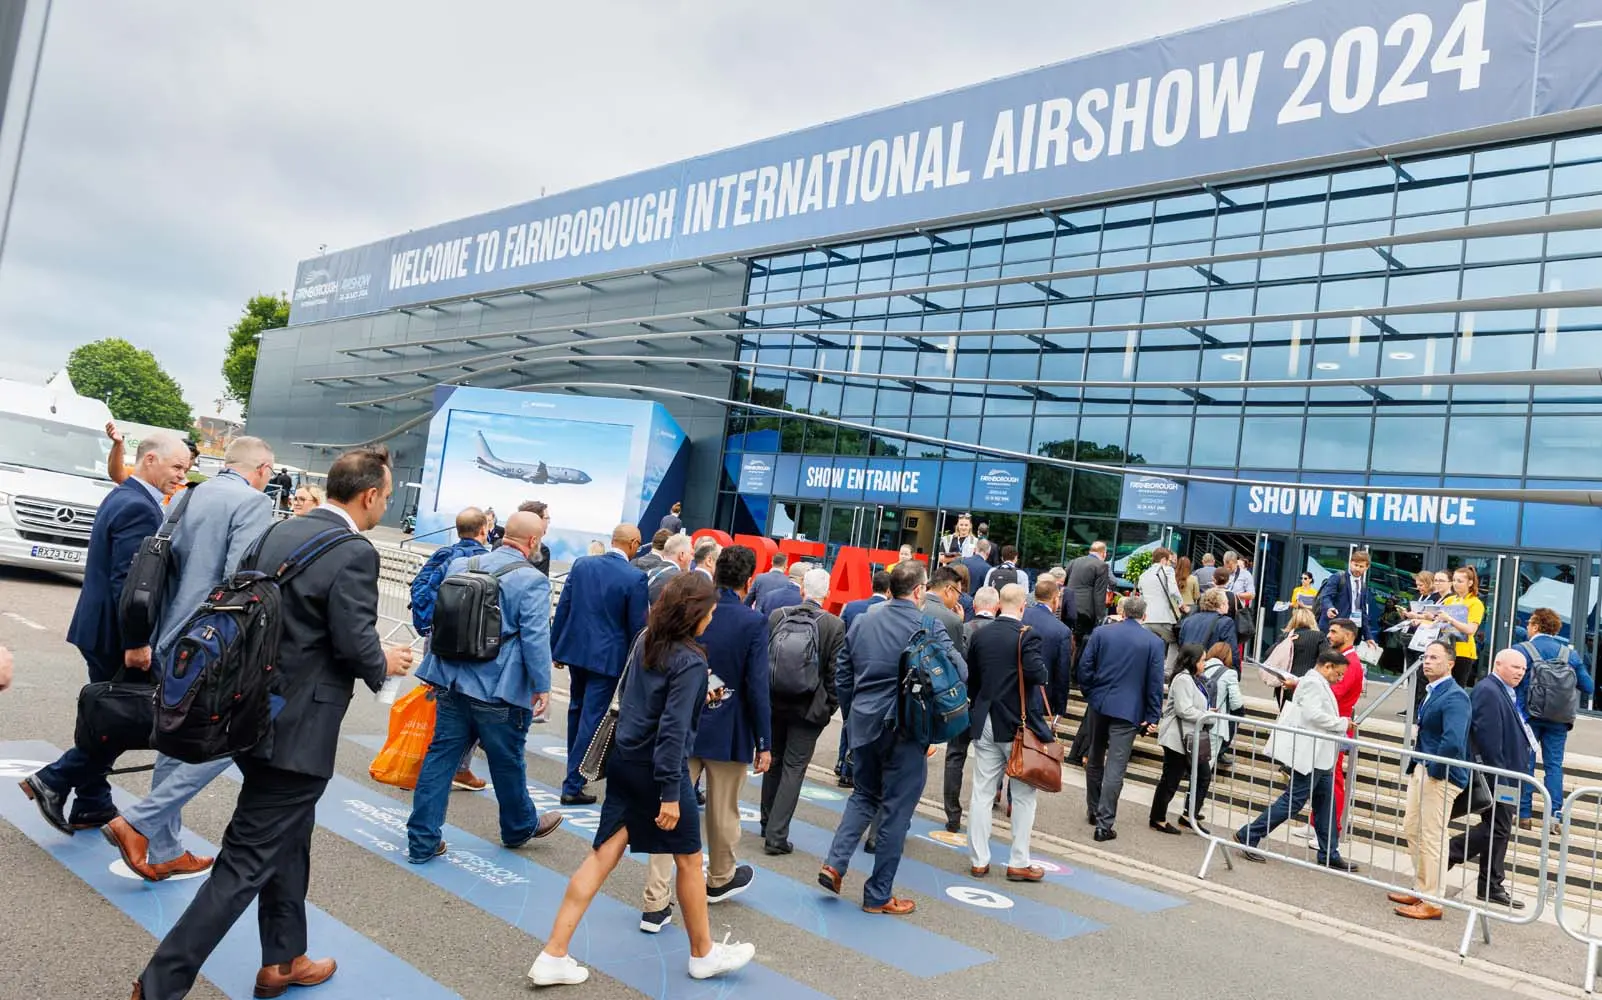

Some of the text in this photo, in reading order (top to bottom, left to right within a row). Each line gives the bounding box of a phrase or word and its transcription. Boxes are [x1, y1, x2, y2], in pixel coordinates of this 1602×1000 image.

[389, 0, 1491, 291] WELCOME TO FARNBOROUGH INTERNATIONAL AIRSHOW 2024
[806, 466, 921, 493] SHOW ENTRANCE
[1248, 485, 1477, 526] SHOW ENTRANCE
